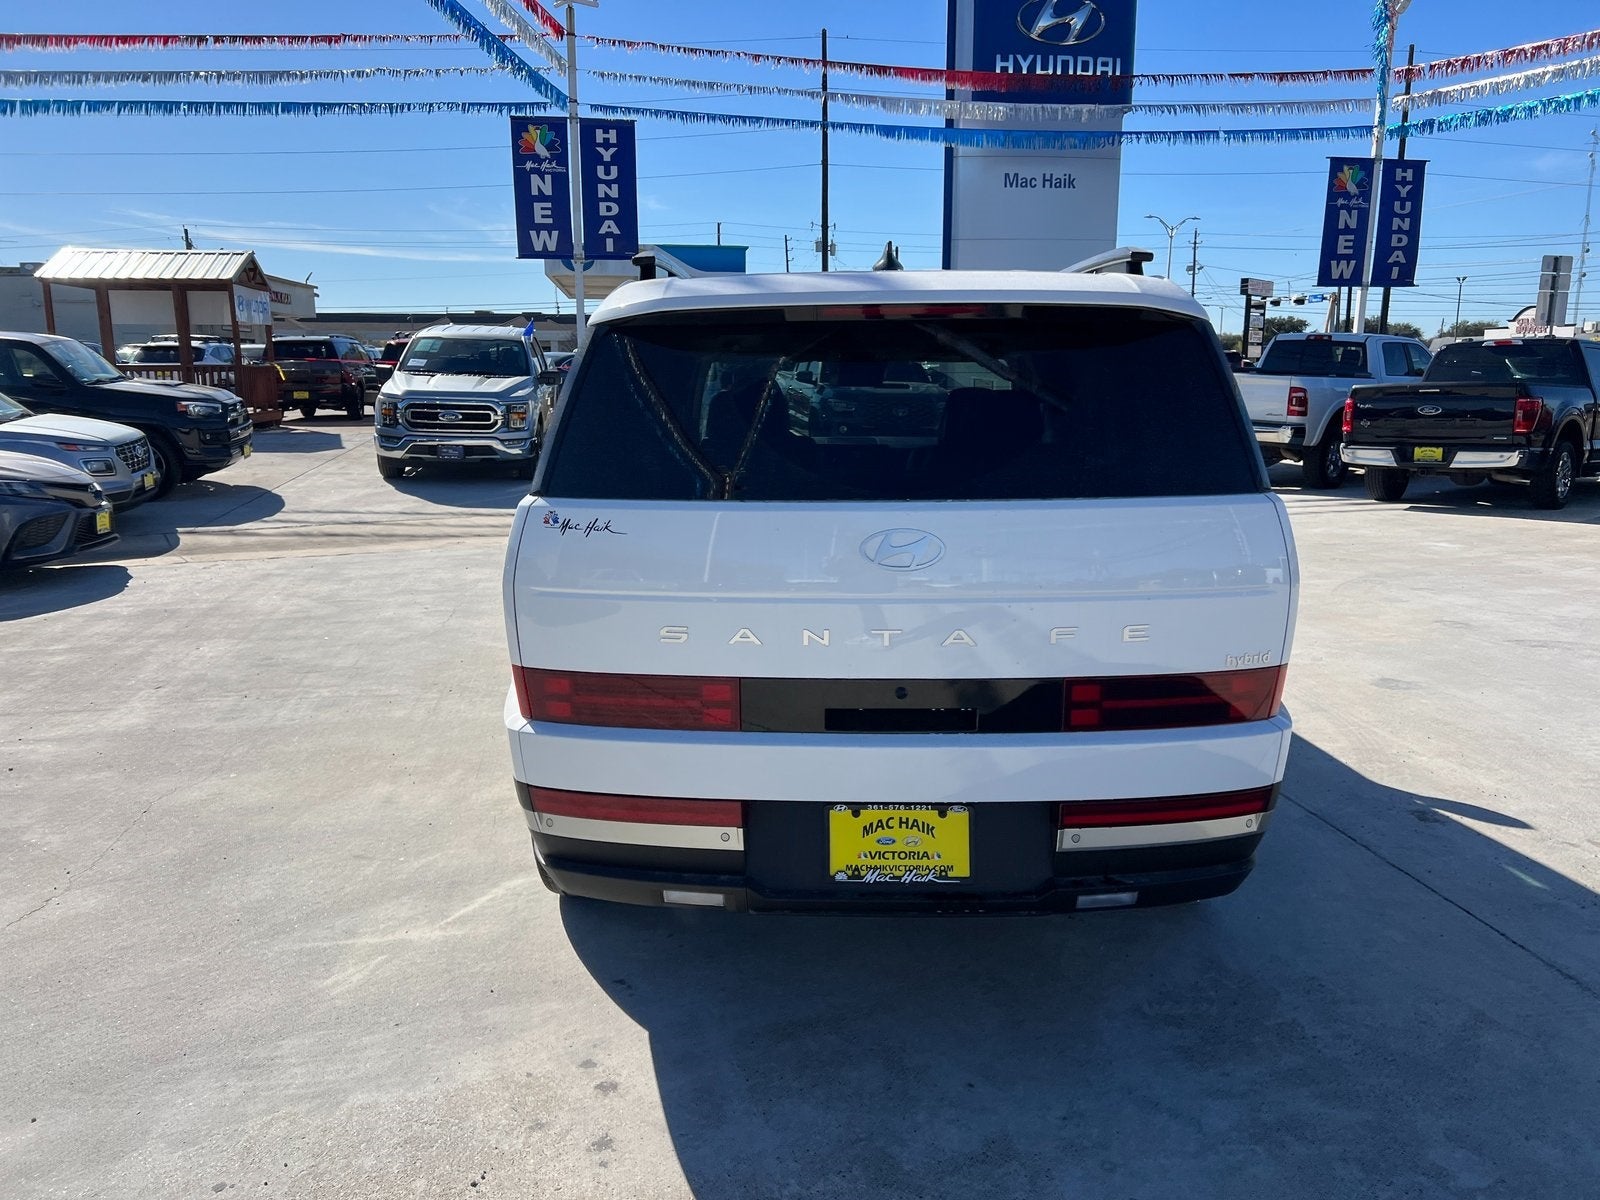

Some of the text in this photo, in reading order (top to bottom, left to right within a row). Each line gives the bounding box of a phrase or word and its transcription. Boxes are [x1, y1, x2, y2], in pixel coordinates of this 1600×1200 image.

[995, 54, 1121, 76] HYUNDAI
[595, 128, 620, 253] HYUNDAI
[1003, 173, 1076, 189] Mac Haik
[529, 174, 559, 252] NEW
[1387, 168, 1414, 280] HYUNDAI
[1330, 210, 1358, 280] NEW
[559, 518, 621, 537] Mac Haik
[658, 623, 1152, 648] SANTA FE
[1225, 650, 1272, 668] hybrid
[862, 816, 936, 839] MAC HAIK
[868, 850, 931, 861] VICTORIA
[862, 869, 944, 885] Mac Haik
